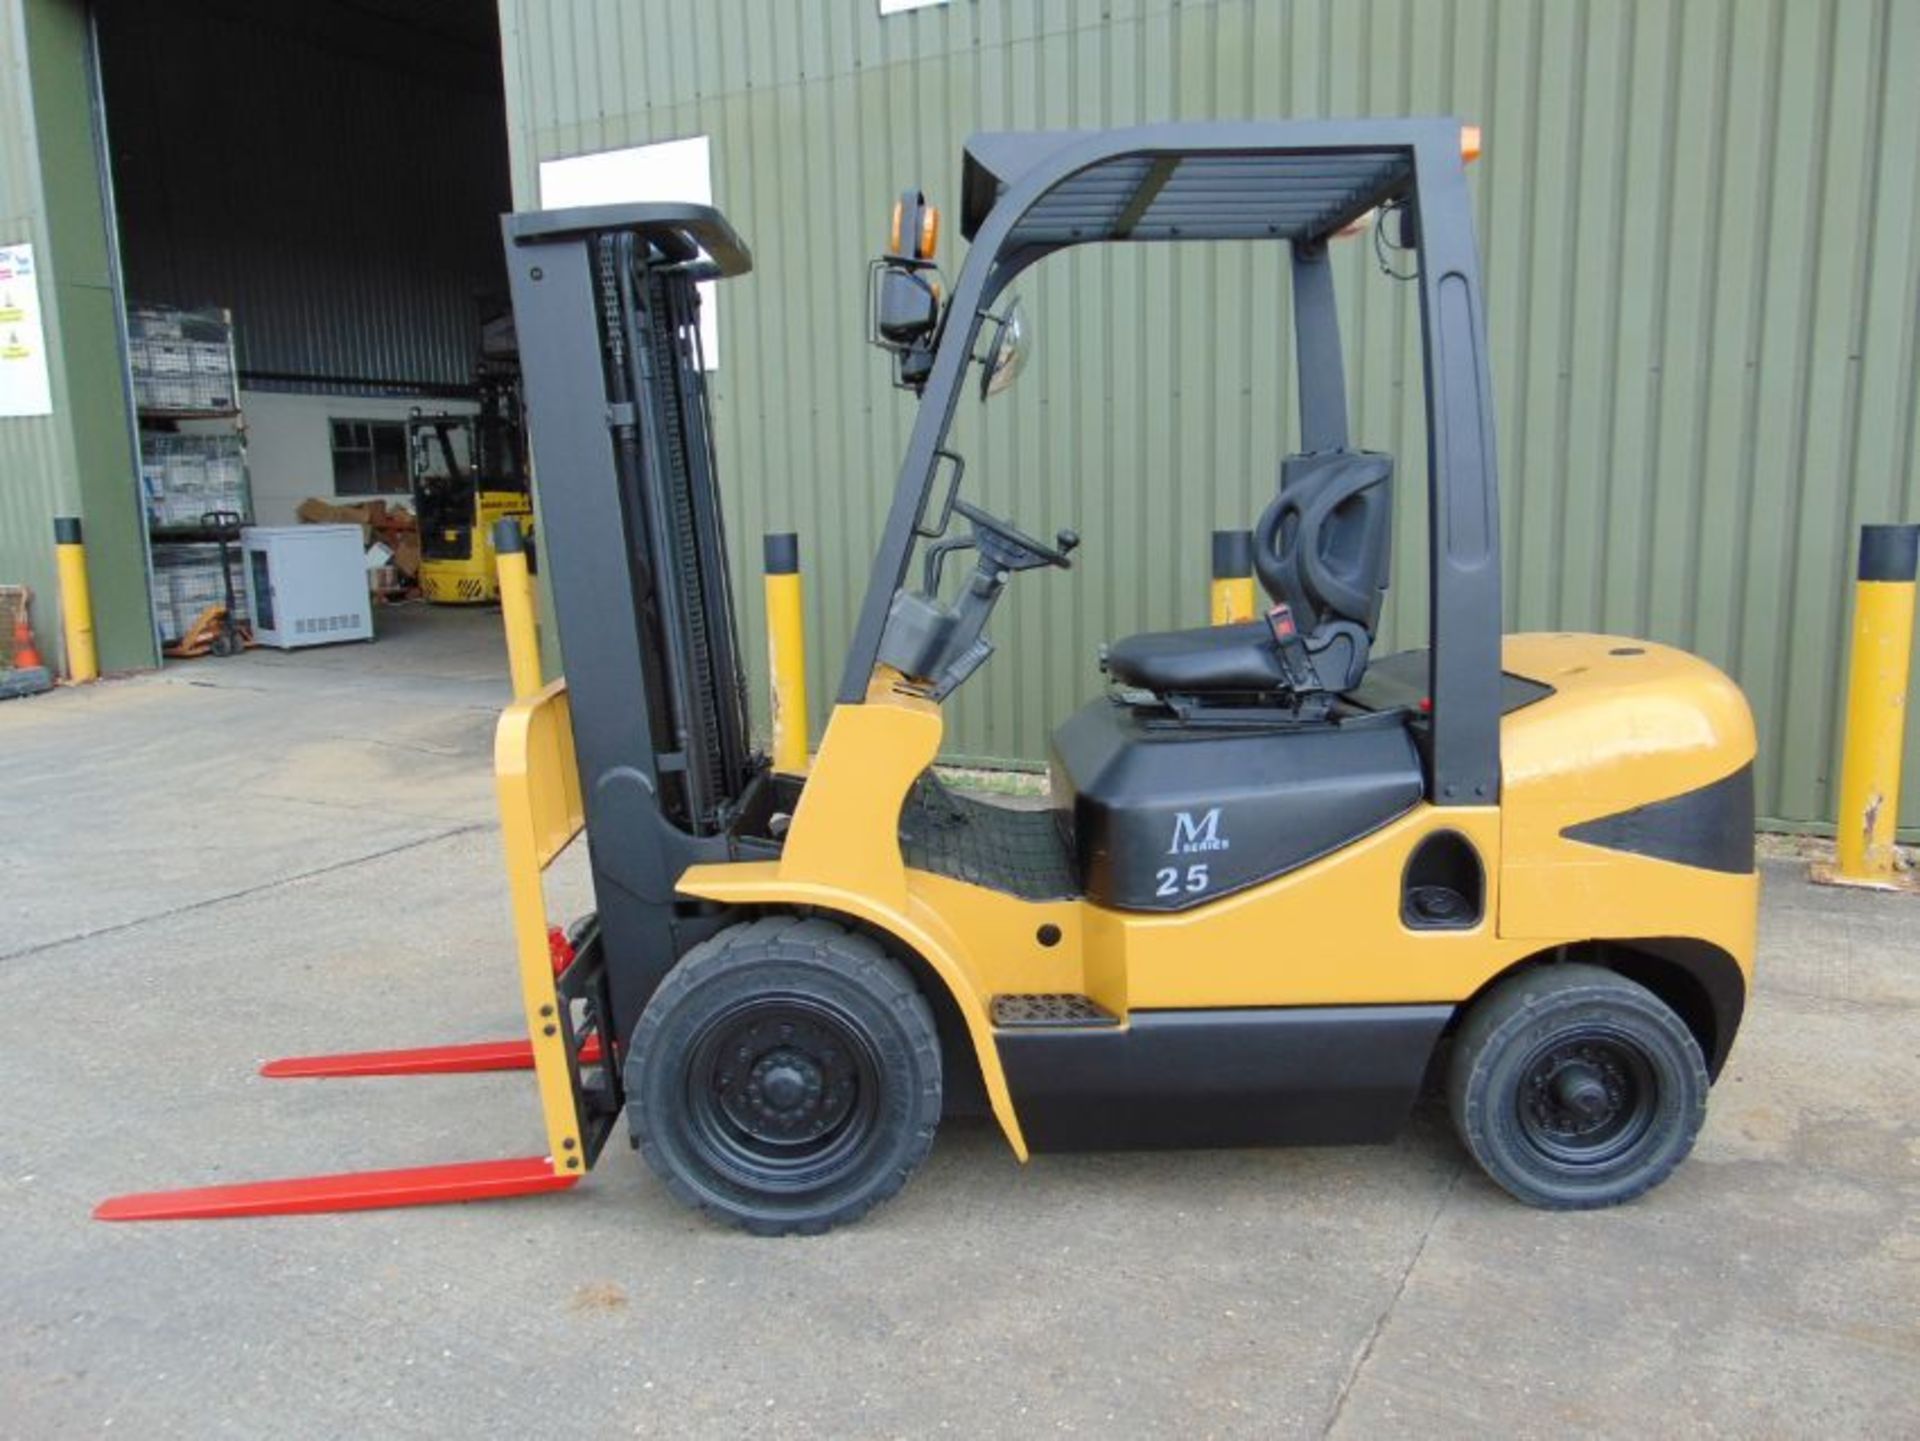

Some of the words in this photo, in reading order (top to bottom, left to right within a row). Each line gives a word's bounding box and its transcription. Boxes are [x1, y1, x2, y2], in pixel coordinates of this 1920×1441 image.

[1166, 808, 1223, 854] M
[1183, 839, 1230, 853] SERIES
[1156, 864, 1209, 897] 25
